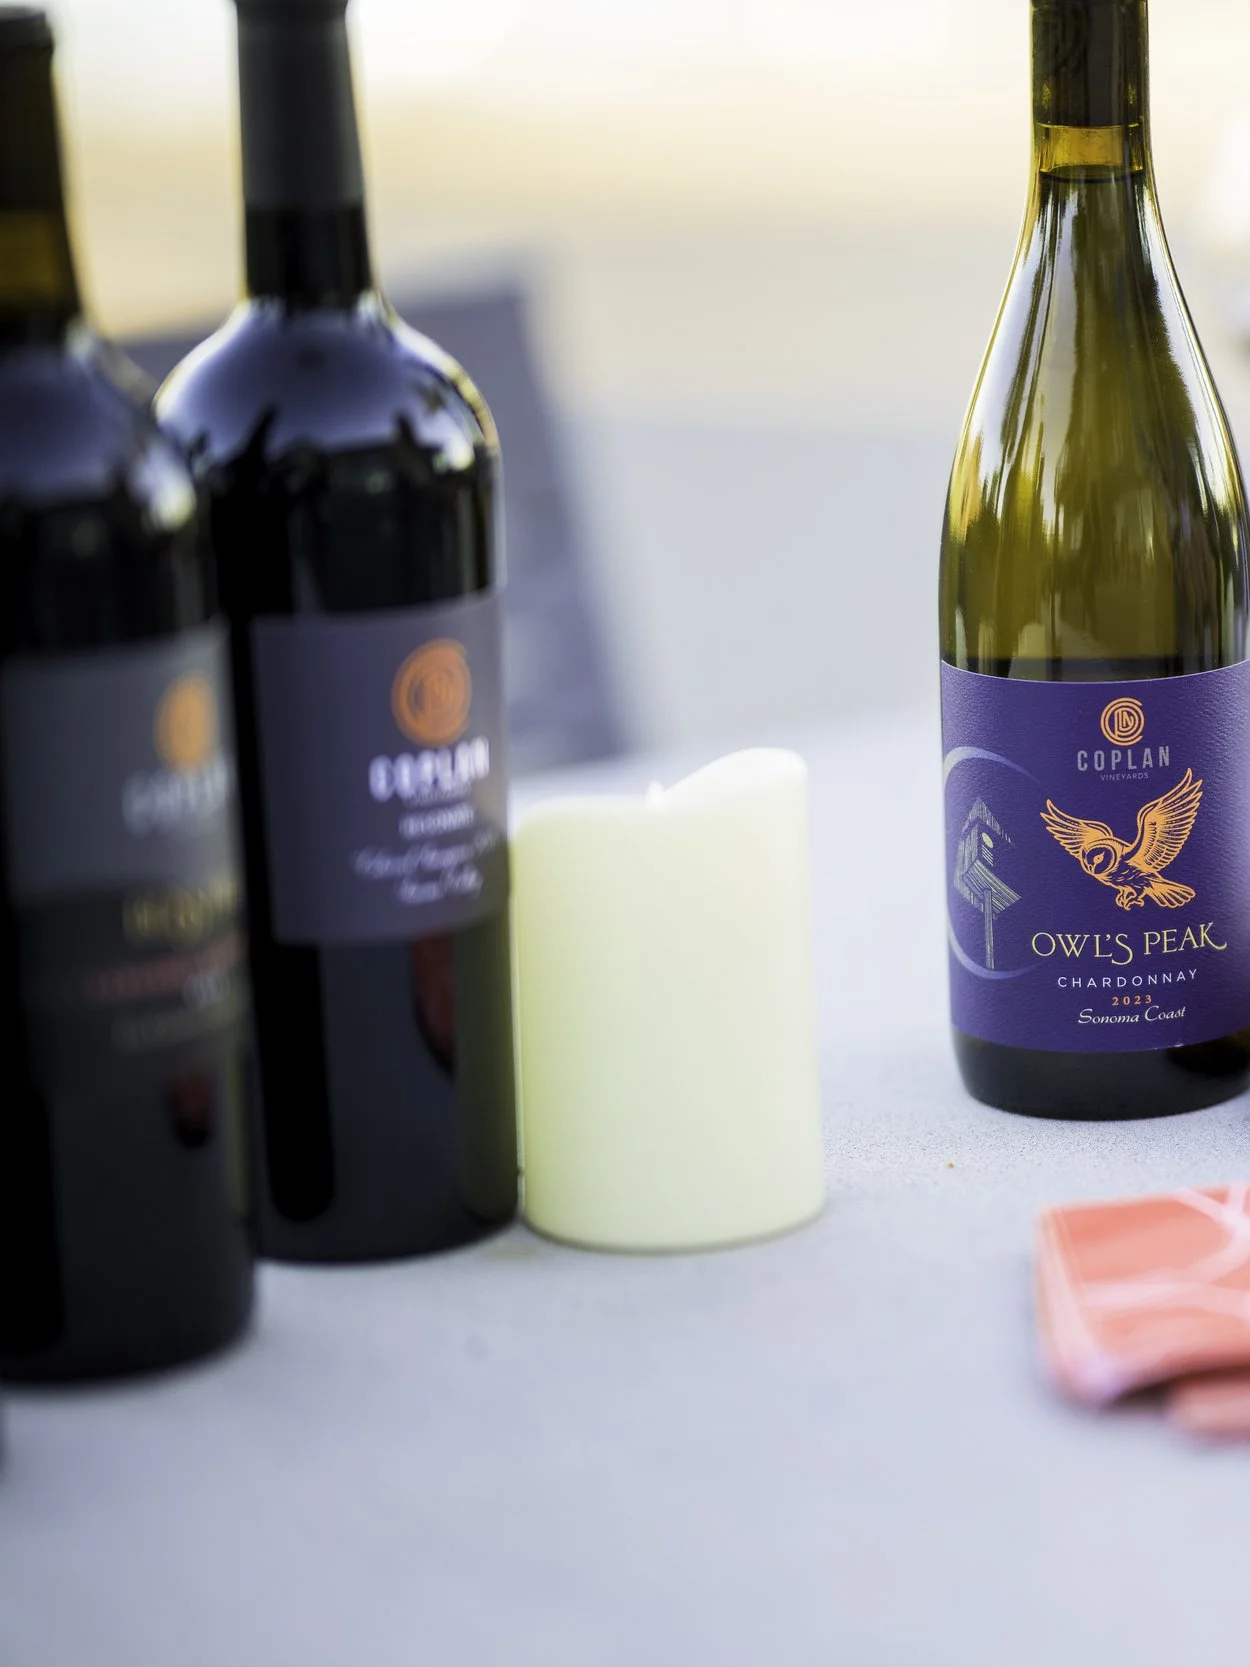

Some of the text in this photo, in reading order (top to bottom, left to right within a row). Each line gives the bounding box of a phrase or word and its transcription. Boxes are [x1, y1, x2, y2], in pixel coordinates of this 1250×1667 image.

[1077, 746, 1170, 771] COPLAN
[1100, 772, 1149, 781] VINEYARDS
[1031, 922, 1228, 966] OWL'S PEAK
[1057, 969, 1198, 988] CHARDONNAY
[1112, 995, 1152, 1006] 2023
[1077, 1005, 1186, 1024] Sonoma Coast
